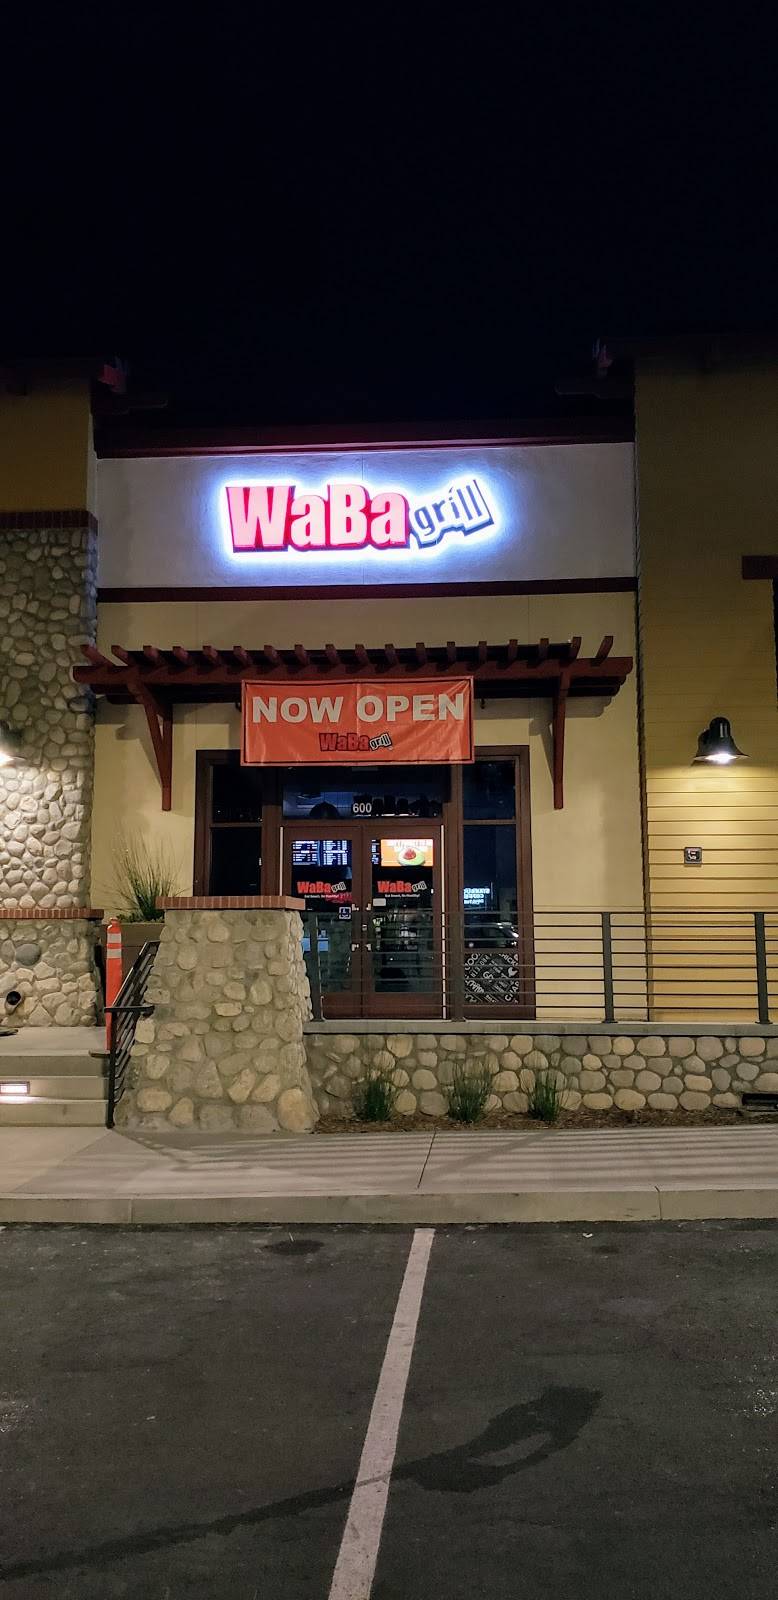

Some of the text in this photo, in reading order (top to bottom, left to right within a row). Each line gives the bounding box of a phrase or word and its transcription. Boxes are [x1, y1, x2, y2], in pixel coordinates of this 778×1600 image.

[226, 482, 485, 552] WaBa grill
[252, 692, 464, 723] NOW OPEN
[319, 732, 391, 752] WaBa grill
[353, 803, 372, 813] 600
[297, 881, 331, 894] WaBa
[377, 881, 412, 893] WaBa
